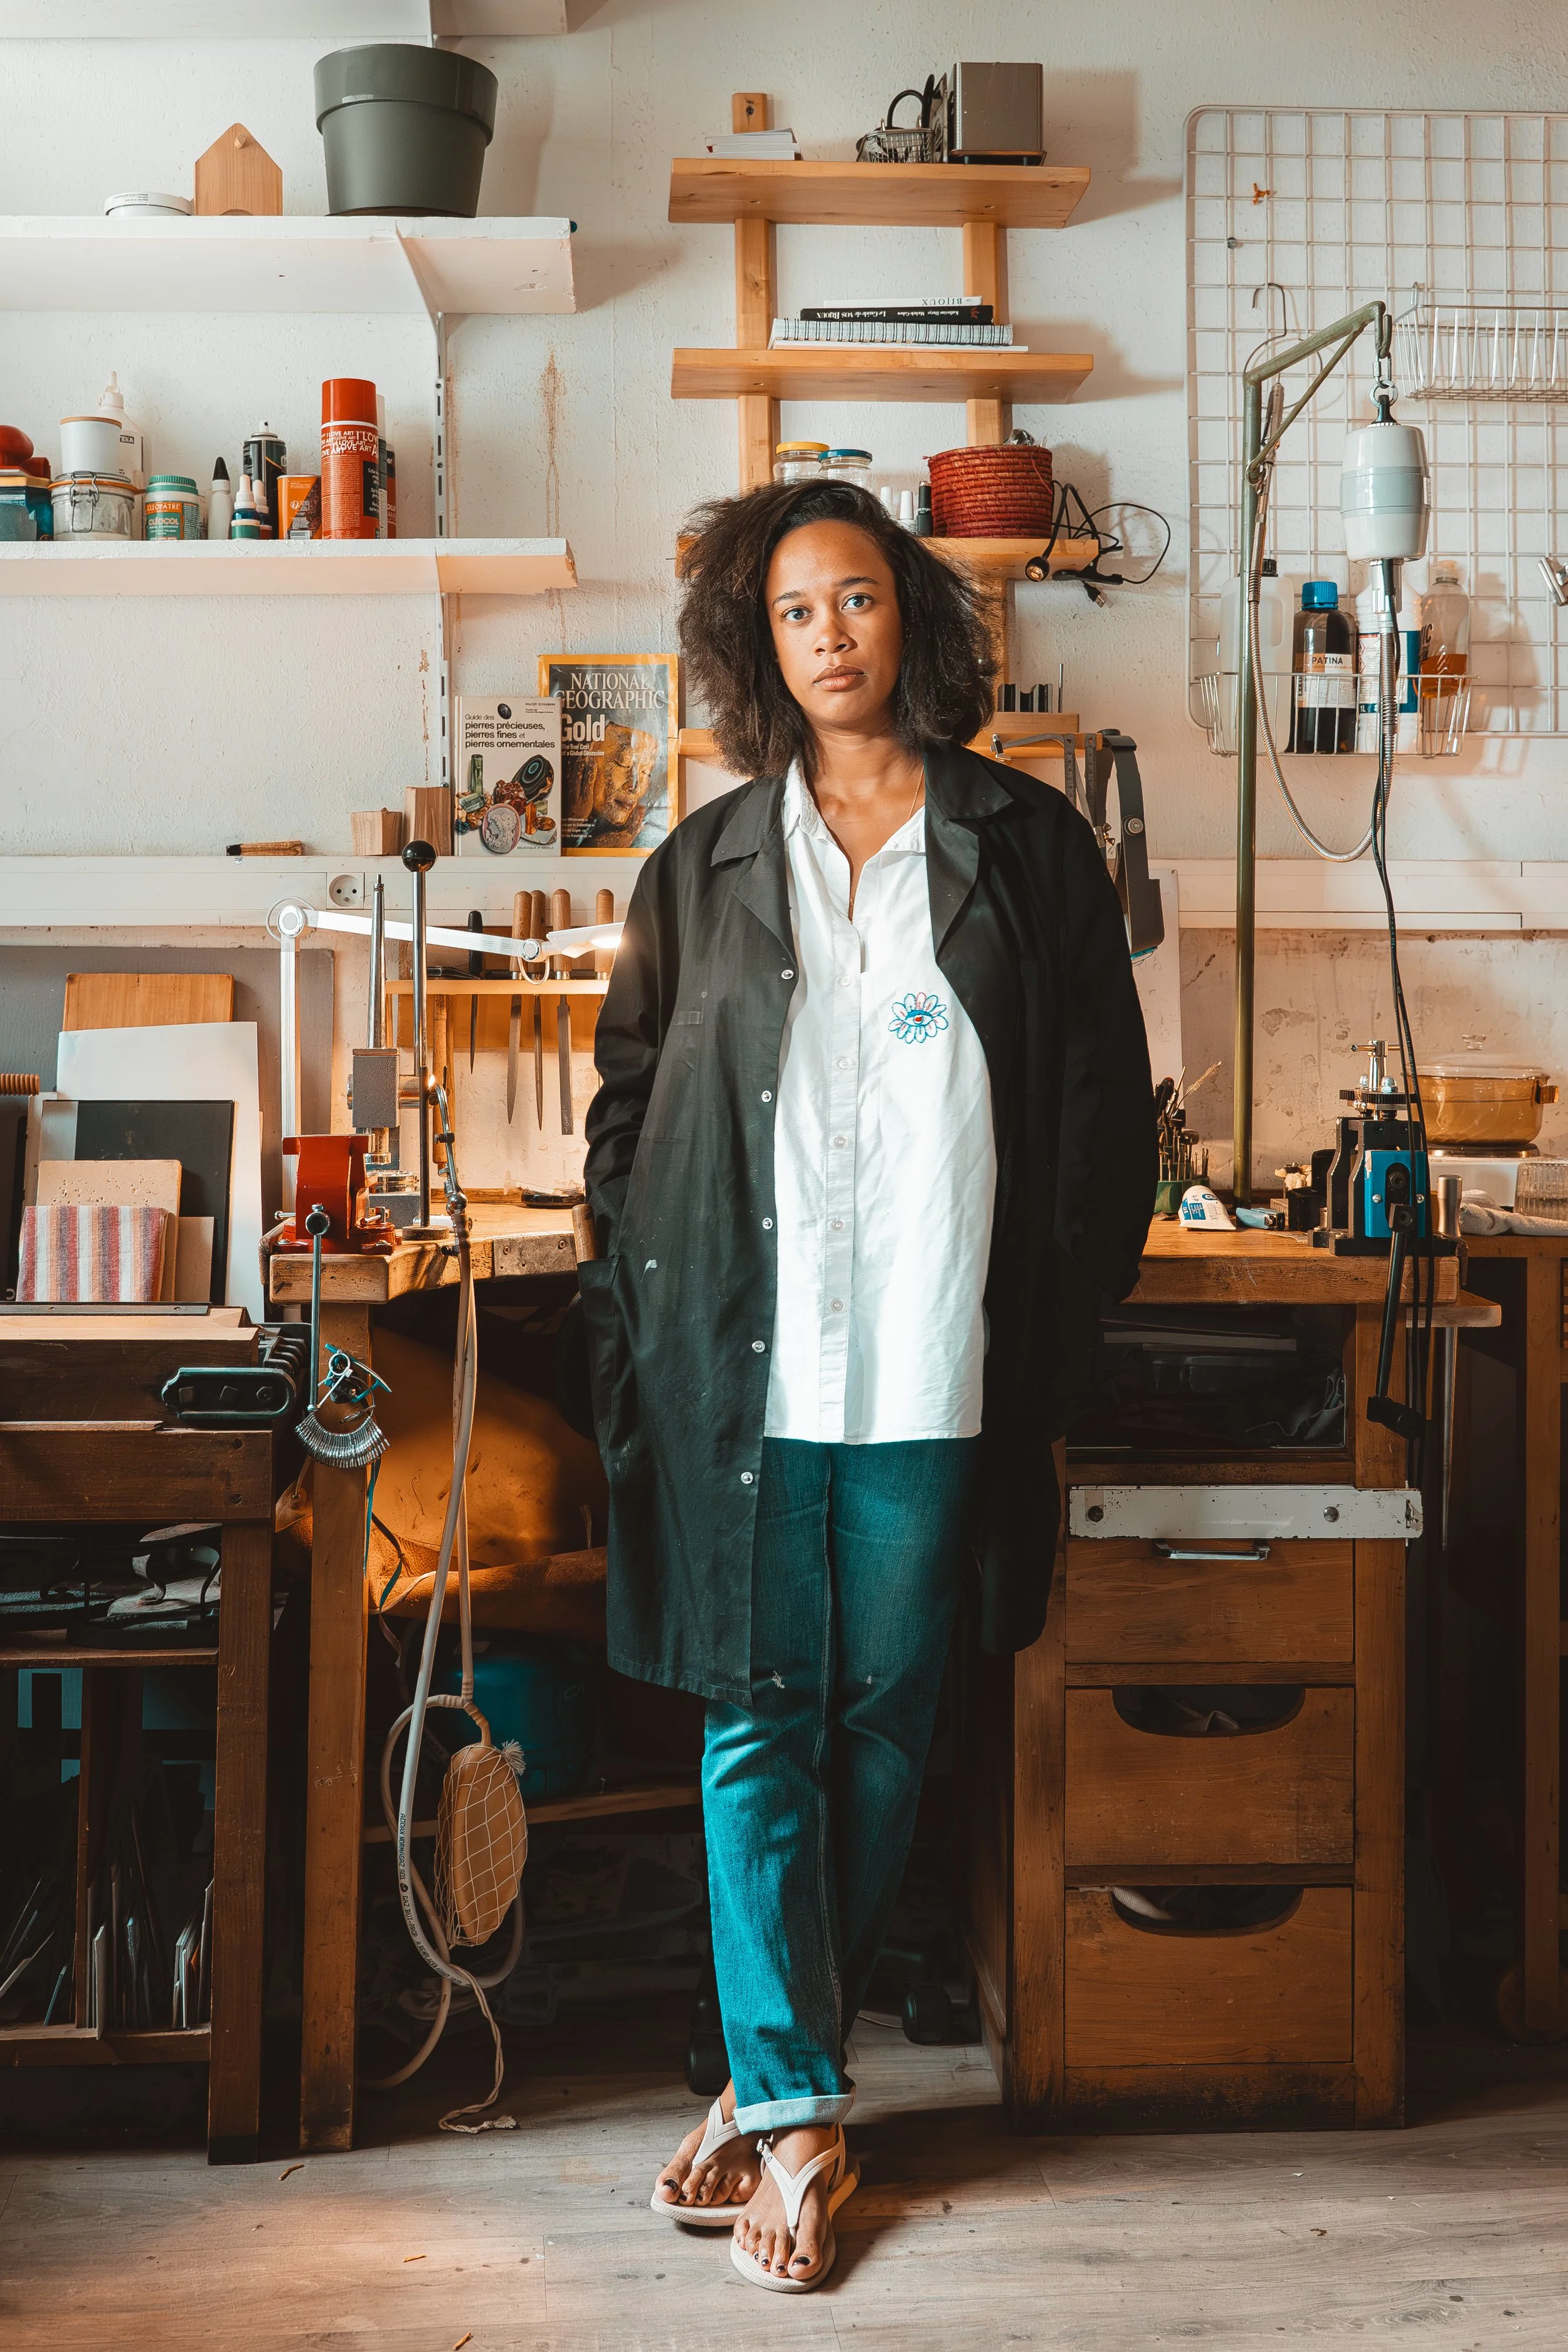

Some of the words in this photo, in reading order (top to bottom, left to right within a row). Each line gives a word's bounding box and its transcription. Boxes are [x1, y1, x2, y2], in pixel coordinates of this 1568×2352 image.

[922, 297, 962, 305] BIJOUX
[363, 431, 379, 443] LOV
[1311, 657, 1343, 665] PATINA
[570, 672, 650, 690] NATIONAL
[553, 690, 665, 709] GEOGRAPHIC
[465, 722, 495, 730] pierres
[496, 721, 546, 731] précieuses,
[561, 713, 605, 741] Gold
[465, 731, 495, 739] pierres
[497, 730, 517, 738] fines
[465, 740, 495, 748] pierres
[496, 740, 556, 748] ornementales
